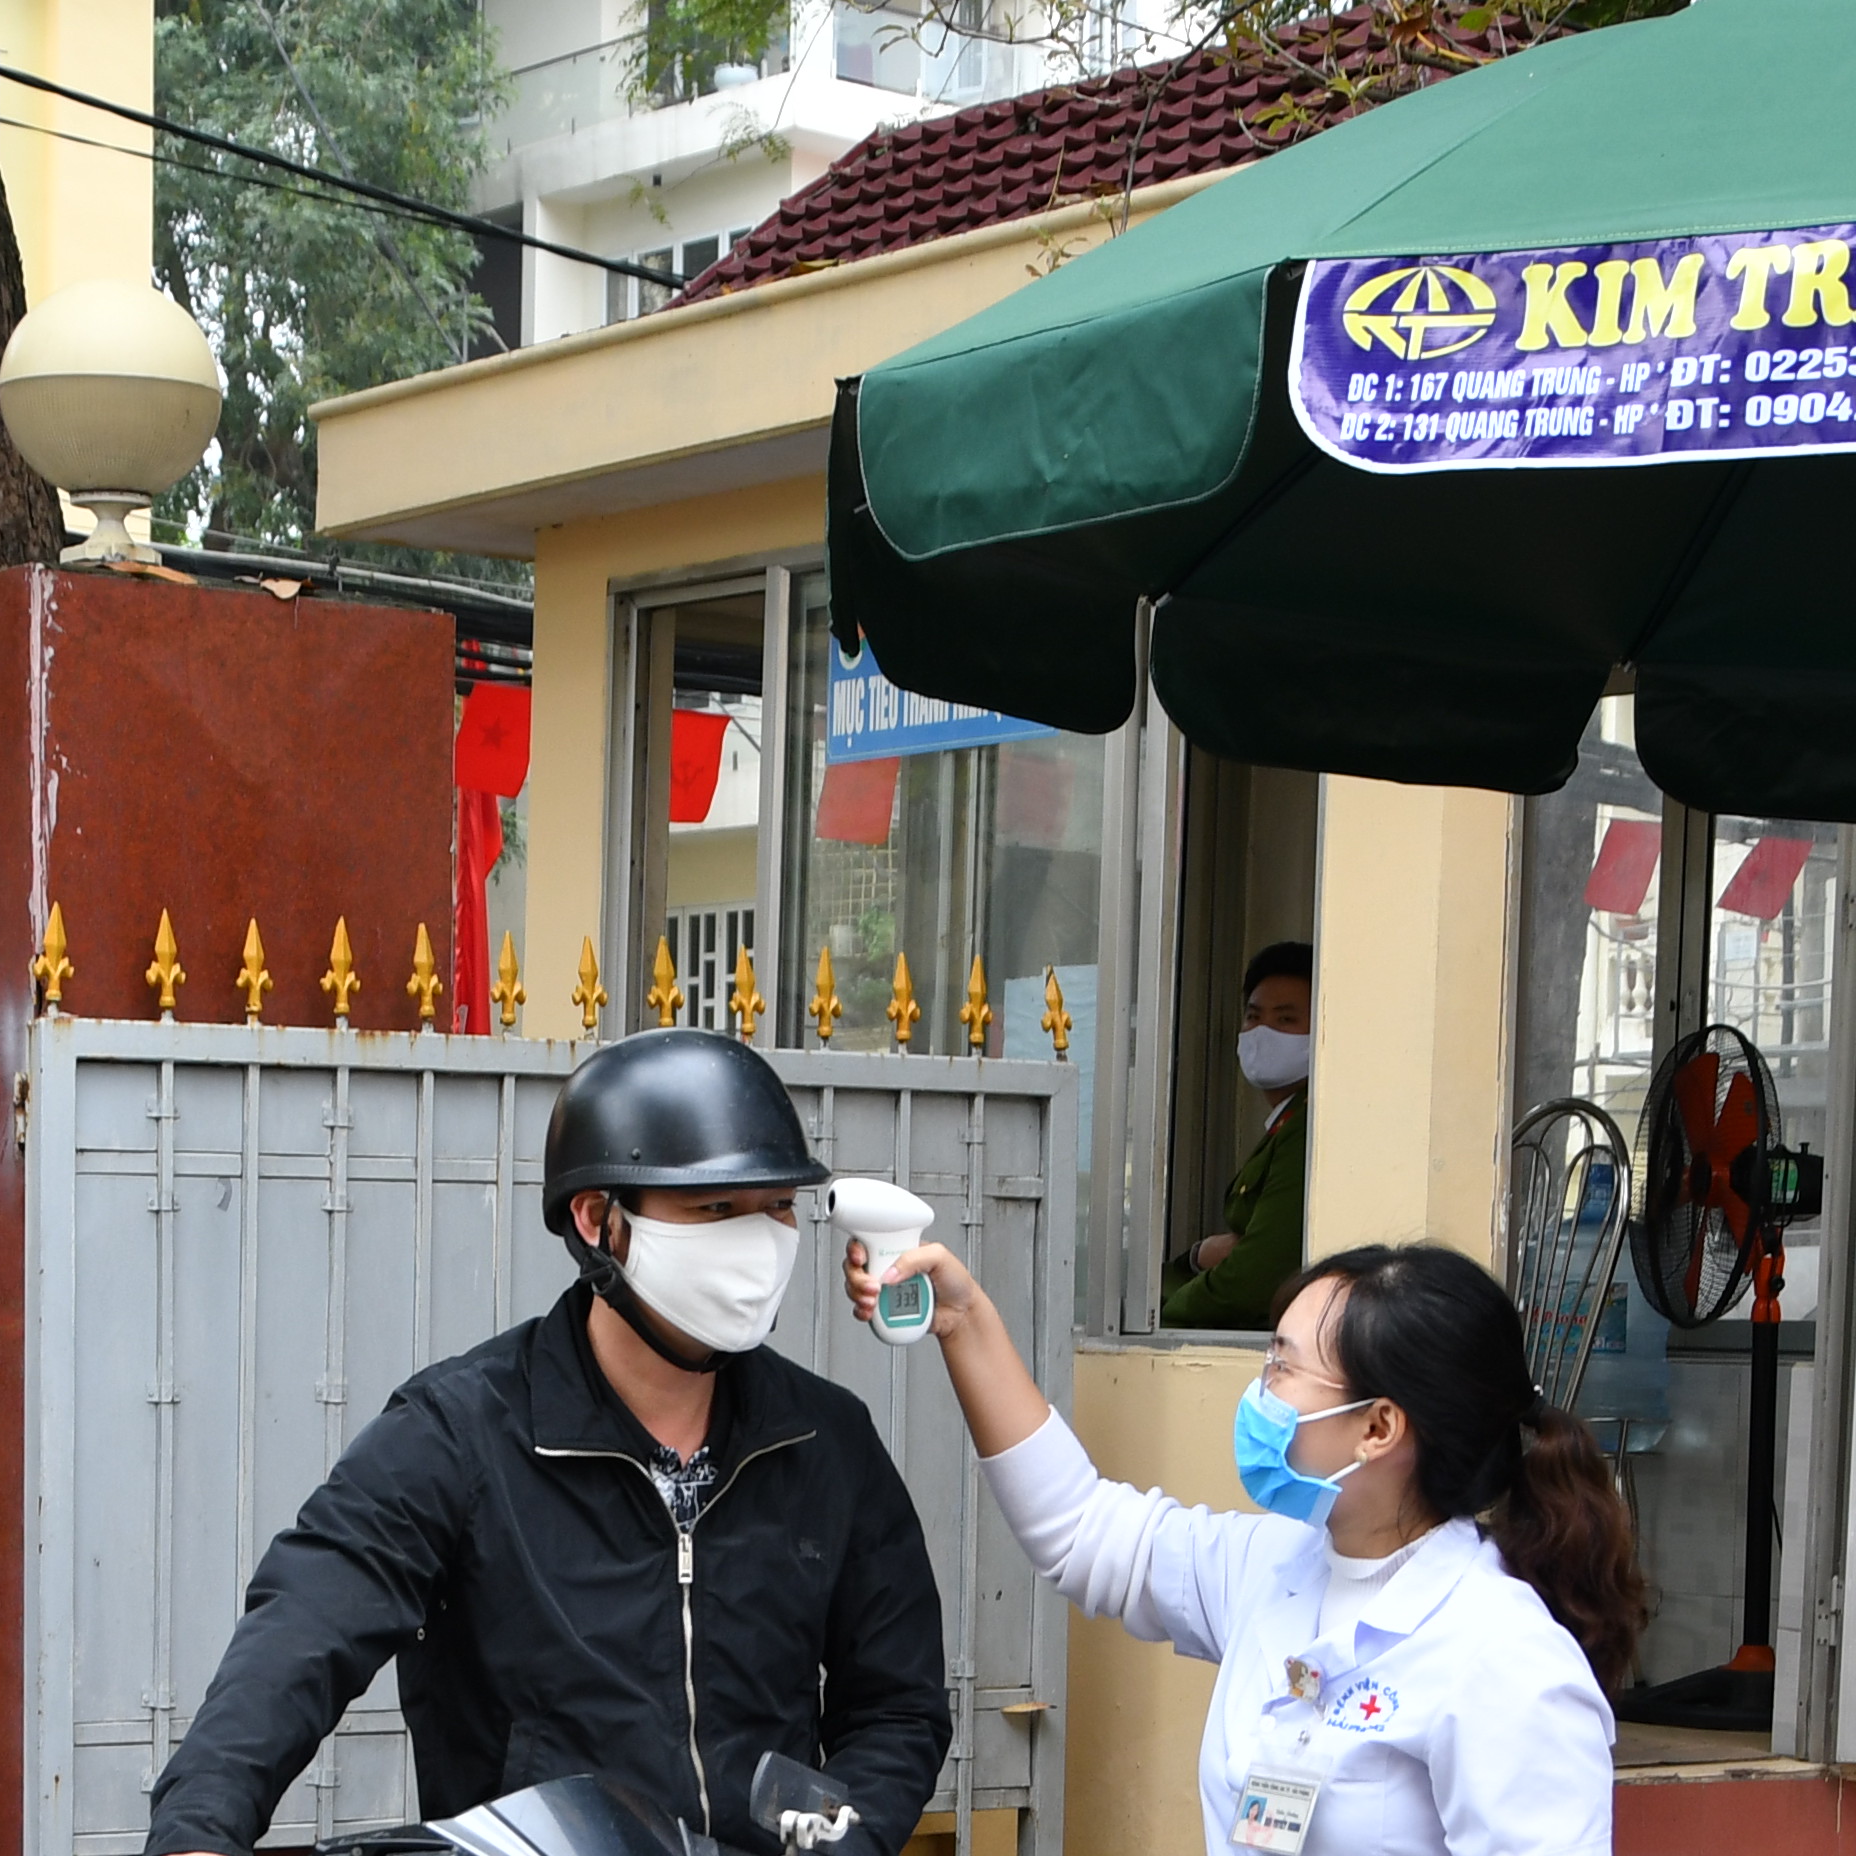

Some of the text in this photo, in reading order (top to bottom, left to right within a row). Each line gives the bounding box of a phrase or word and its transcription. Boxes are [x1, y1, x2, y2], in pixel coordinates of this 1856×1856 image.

[1515, 253, 1705, 351] KIM
[1348, 373, 1377, 401] ĐC
[1384, 372, 1403, 401] 1:
[1410, 371, 1448, 401] 167
[1452, 369, 1525, 402] QUANG
[1531, 366, 1602, 398] TRUNG
[1620, 362, 1650, 393] HP
[1670, 354, 1732, 388] ĐT:
[1341, 412, 1370, 440] ĐC
[1374, 412, 1395, 441] 2:
[1403, 412, 1438, 441] 131
[1445, 409, 1519, 443] QUANG
[1524, 406, 1595, 437] TRUNG
[1613, 404, 1644, 435] HP
[1665, 397, 1732, 431] ĐT:
[832, 677, 865, 748] MỤC
